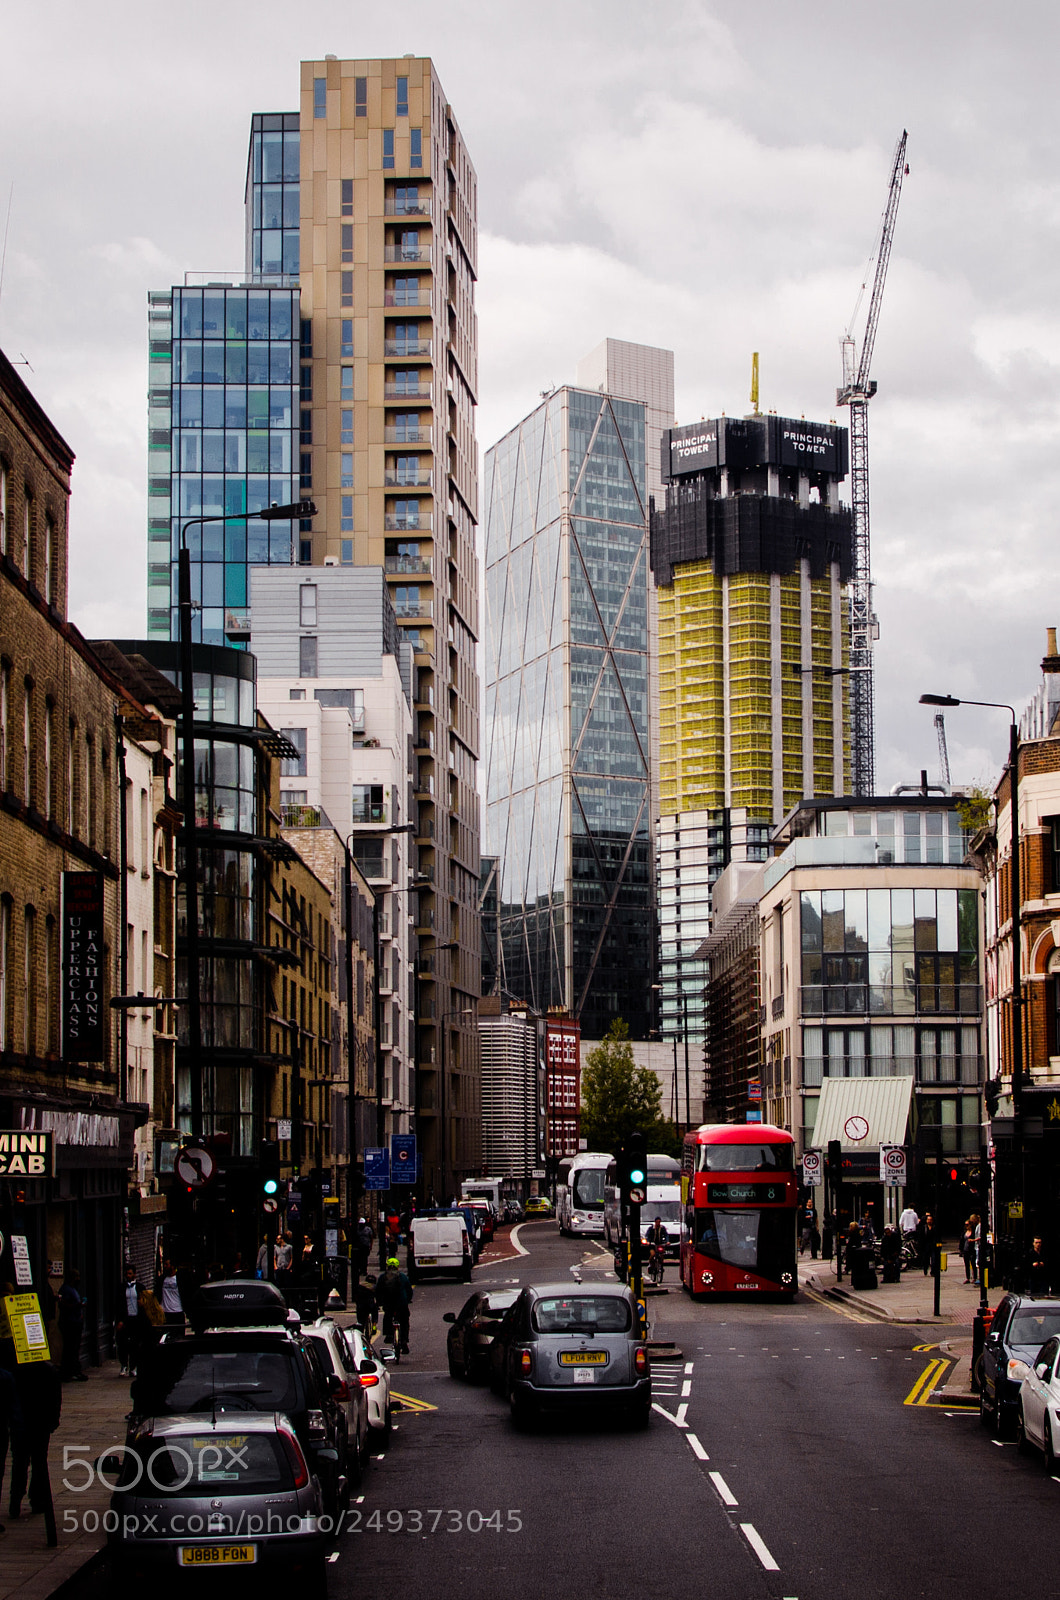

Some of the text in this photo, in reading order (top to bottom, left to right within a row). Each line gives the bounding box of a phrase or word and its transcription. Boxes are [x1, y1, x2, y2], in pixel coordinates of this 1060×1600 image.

[671, 432, 717, 450] PRINCIPAL
[783, 431, 834, 447] PRINCIPAL
[678, 443, 709, 457] TOWER
[792, 441, 826, 454] TOWER
[68, 917, 81, 1038] UPPERCLASS
[85, 930, 99, 1027] FASHIONS
[806, 1157, 817, 1165] 20
[889, 1155, 902, 1163] 20
[712, 1187, 775, 1199] Bow Church 8
